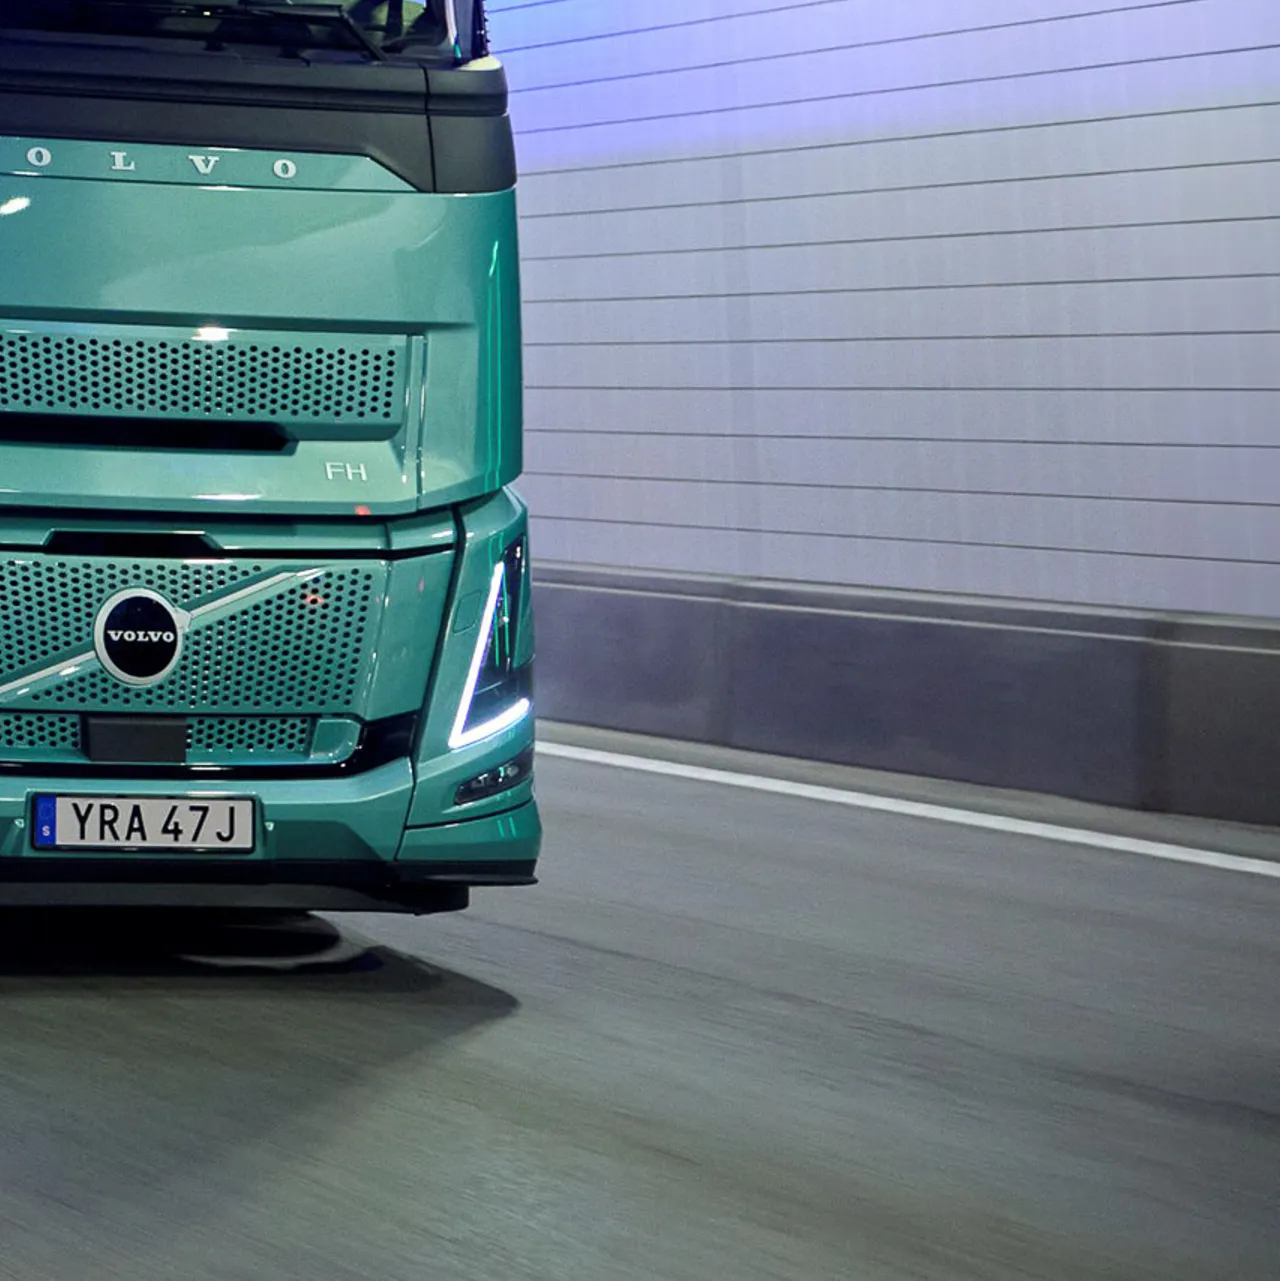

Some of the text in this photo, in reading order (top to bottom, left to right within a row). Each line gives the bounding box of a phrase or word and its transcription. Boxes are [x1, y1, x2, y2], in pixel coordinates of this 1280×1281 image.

[325, 461, 368, 481] FH
[106, 629, 175, 643] VOLVO
[42, 803, 235, 842] S YRA 47J
